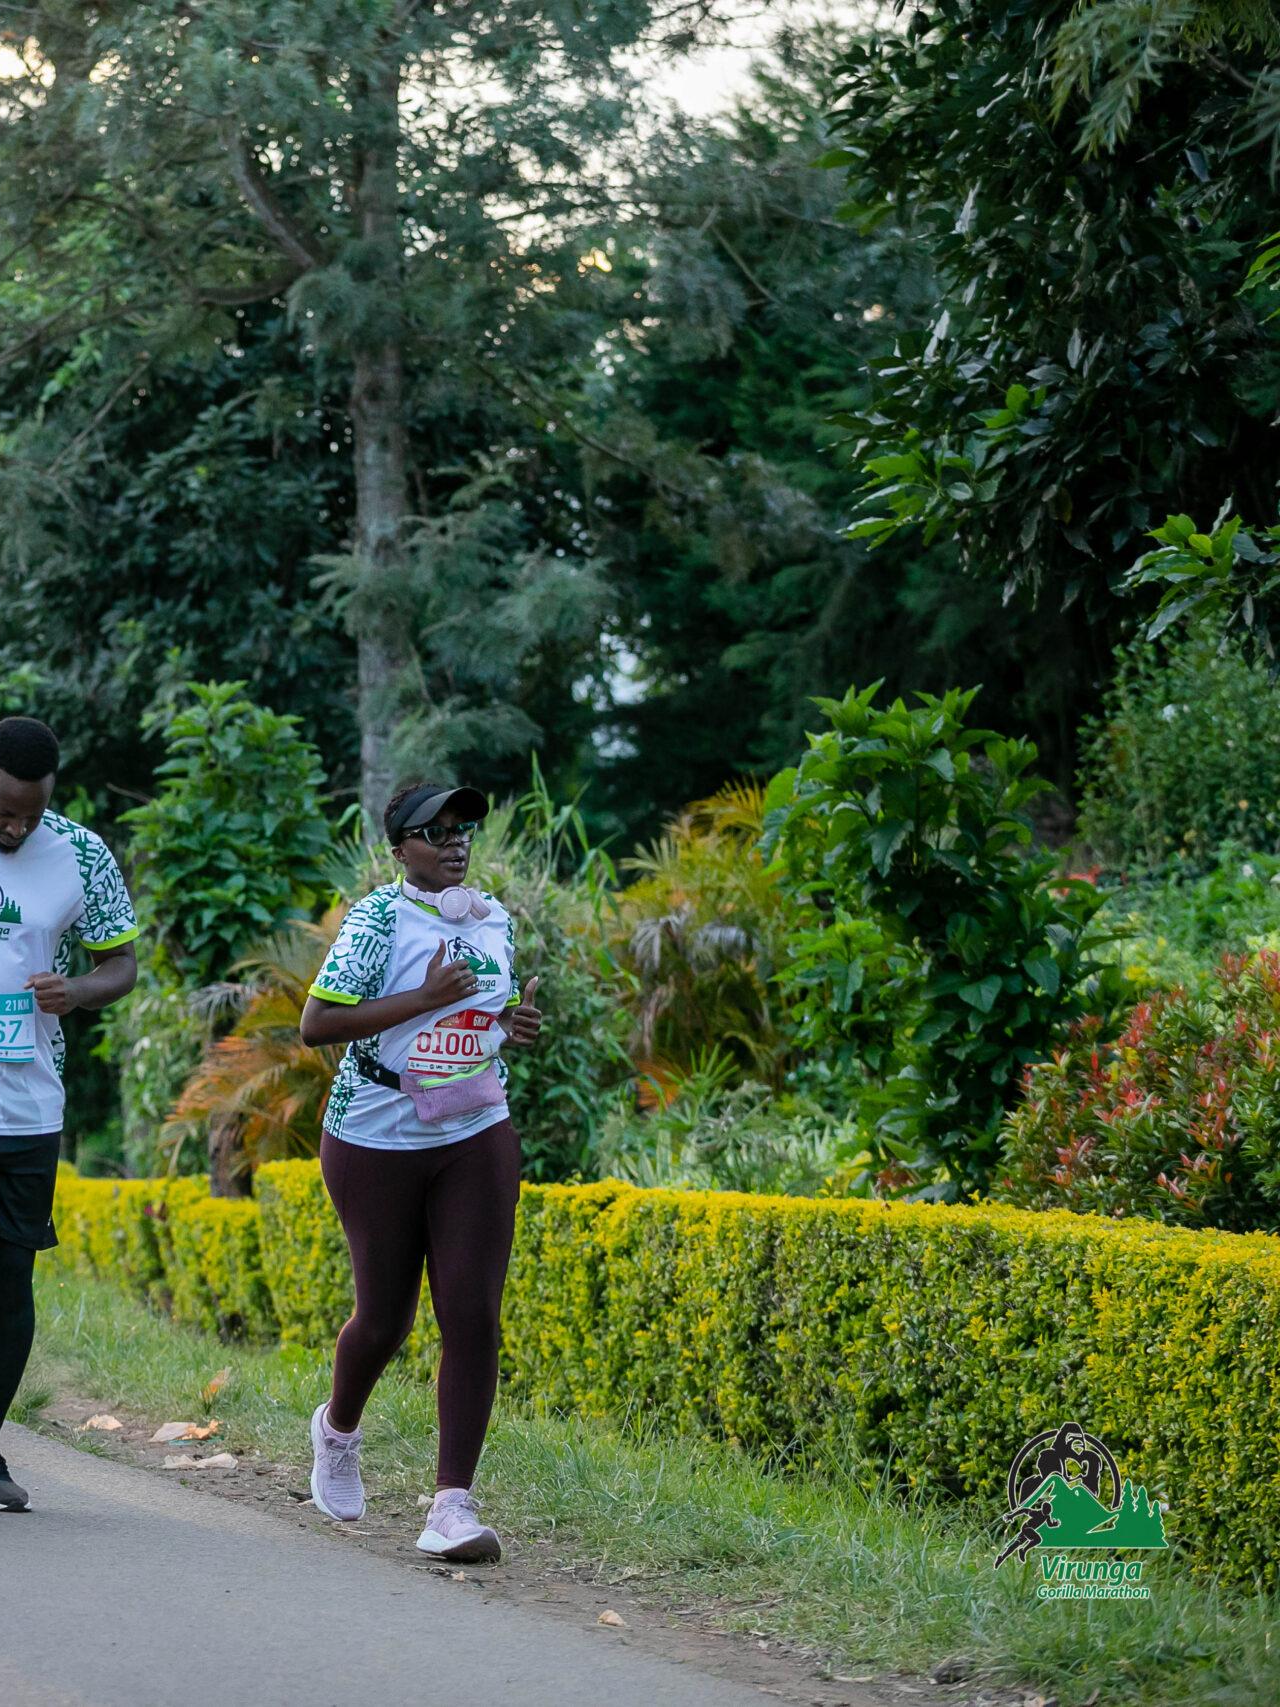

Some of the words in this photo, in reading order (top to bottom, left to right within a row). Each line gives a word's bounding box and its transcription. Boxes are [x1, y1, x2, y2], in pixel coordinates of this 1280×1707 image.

[5, 999, 30, 1012] 21KM
[473, 1015, 490, 1027] 6KM
[416, 1031, 484, 1057] 01001
